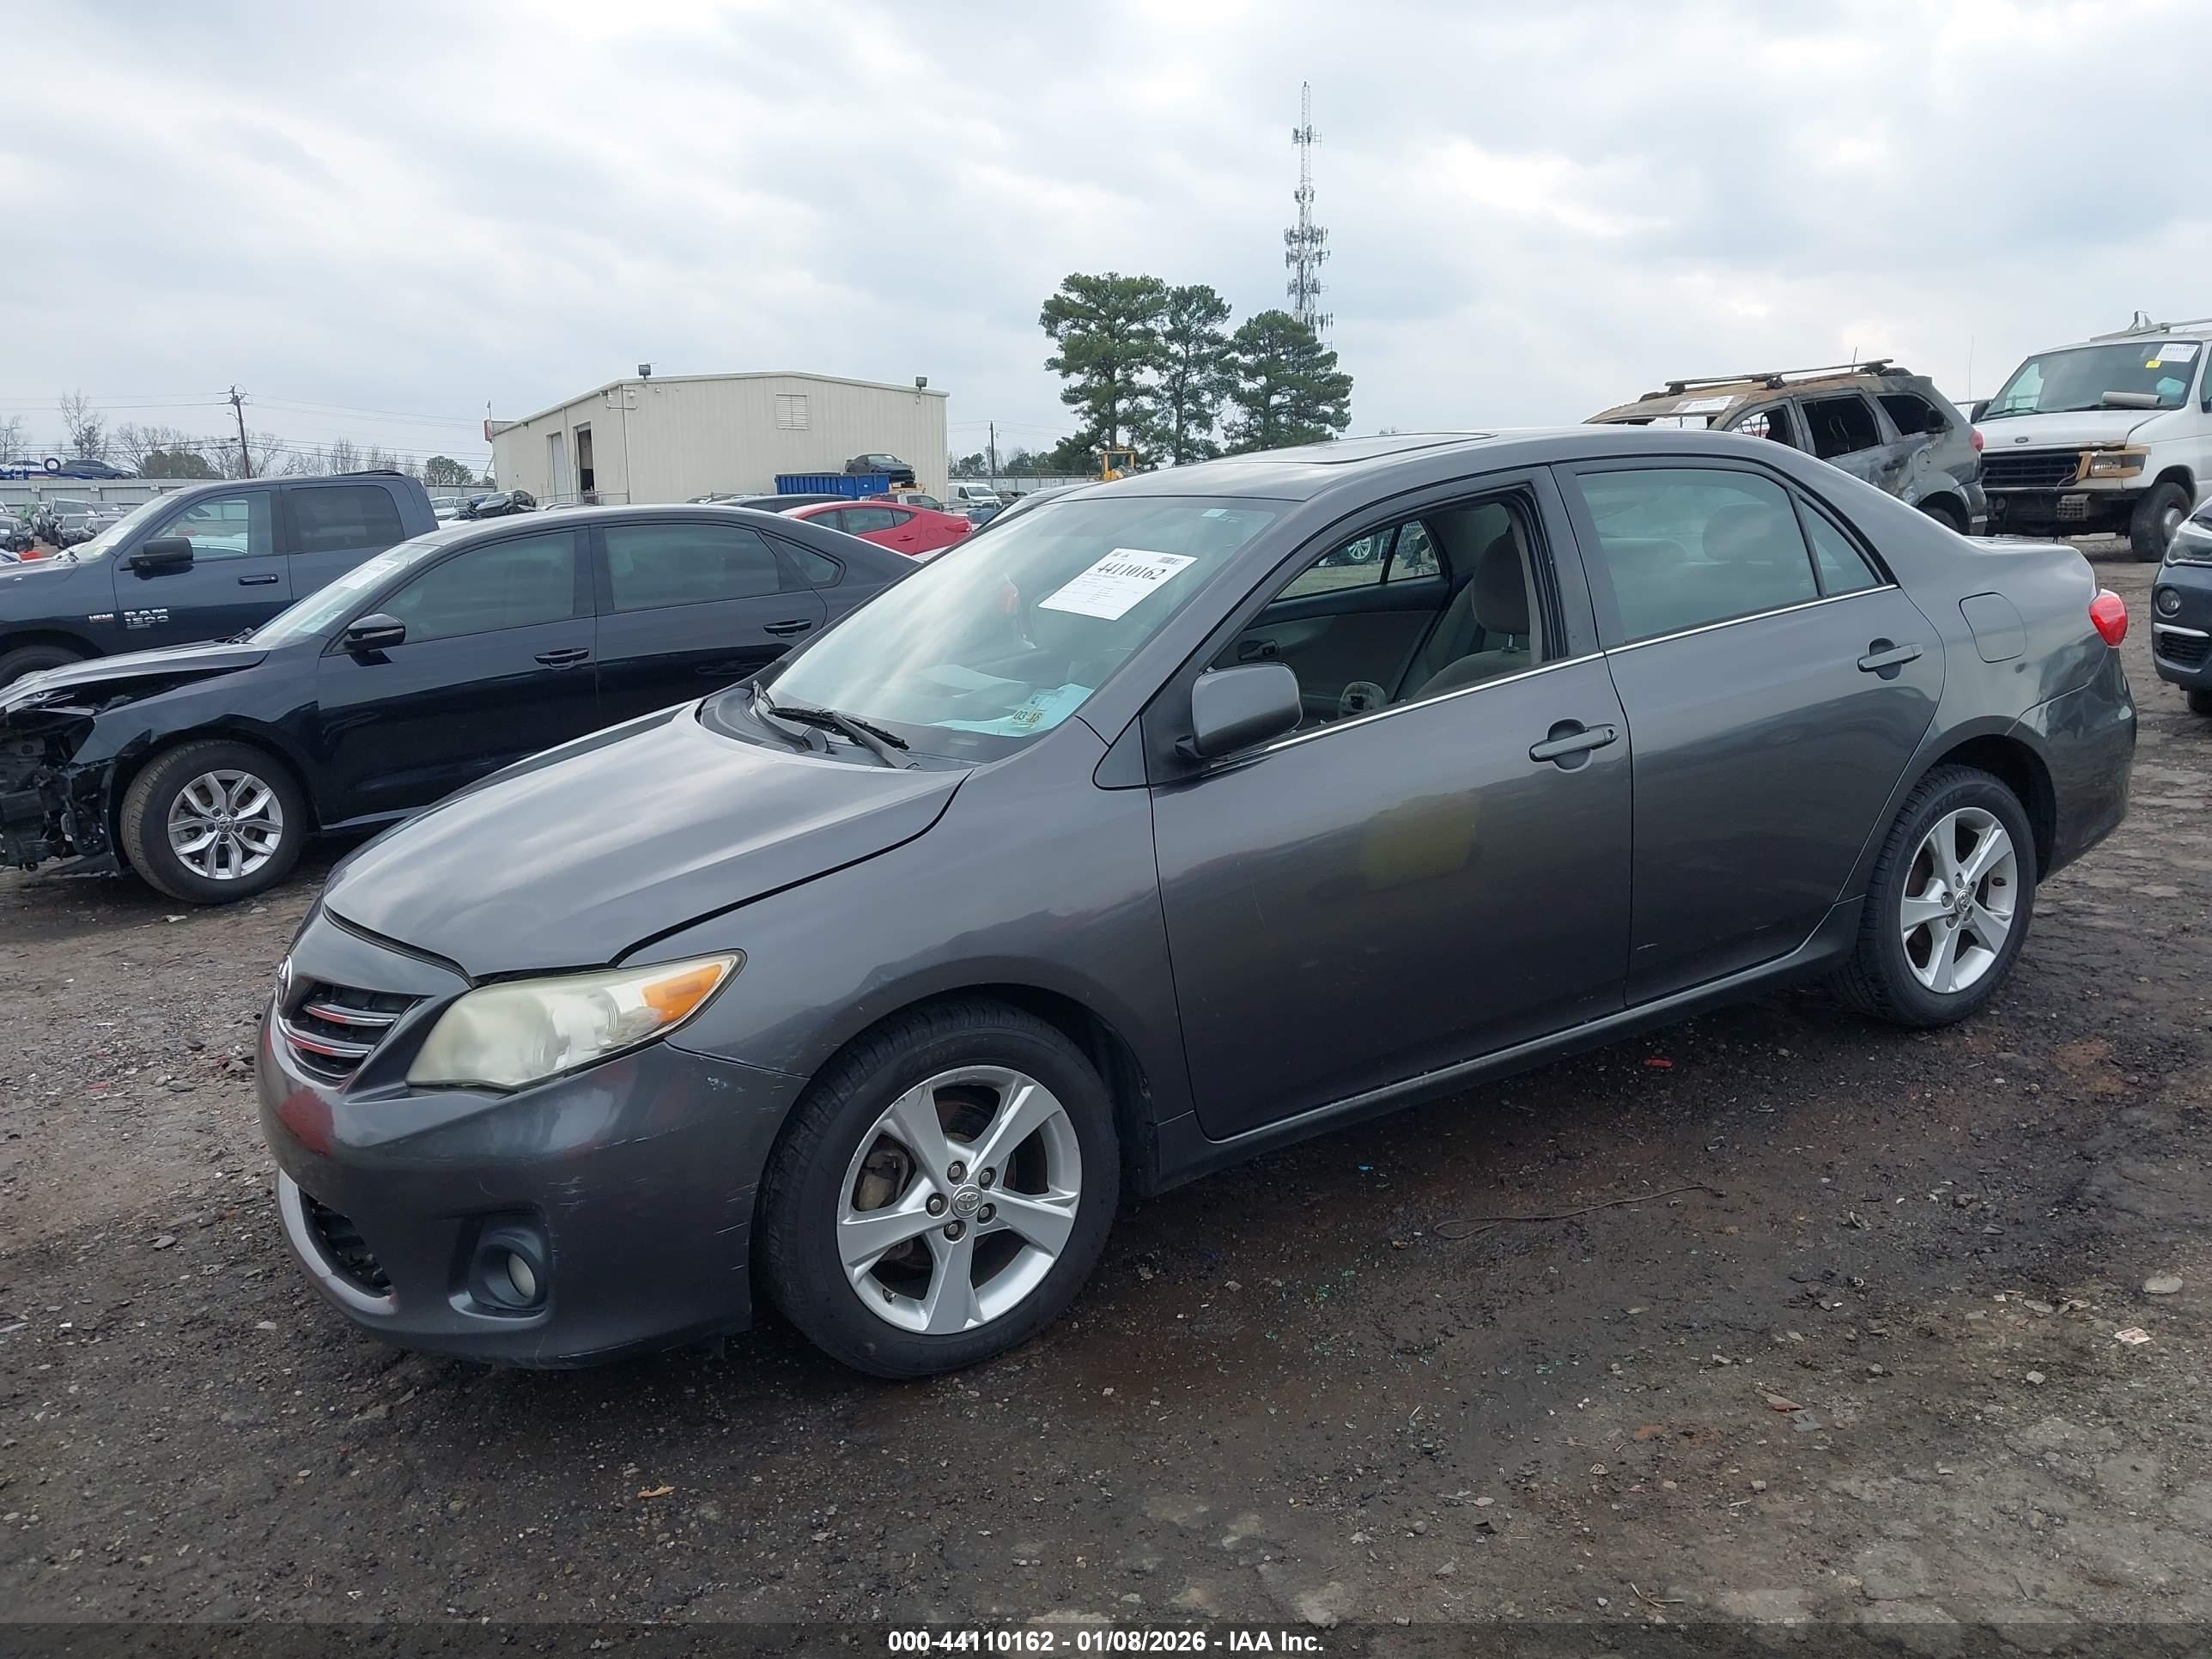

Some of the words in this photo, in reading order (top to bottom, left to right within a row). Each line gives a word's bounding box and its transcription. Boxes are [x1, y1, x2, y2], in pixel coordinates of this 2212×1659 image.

[1097, 562, 1167, 580] 44110162
[124, 608, 167, 617] RAM
[125, 615, 169, 625] 1500
[1012, 710, 1028, 720] 03
